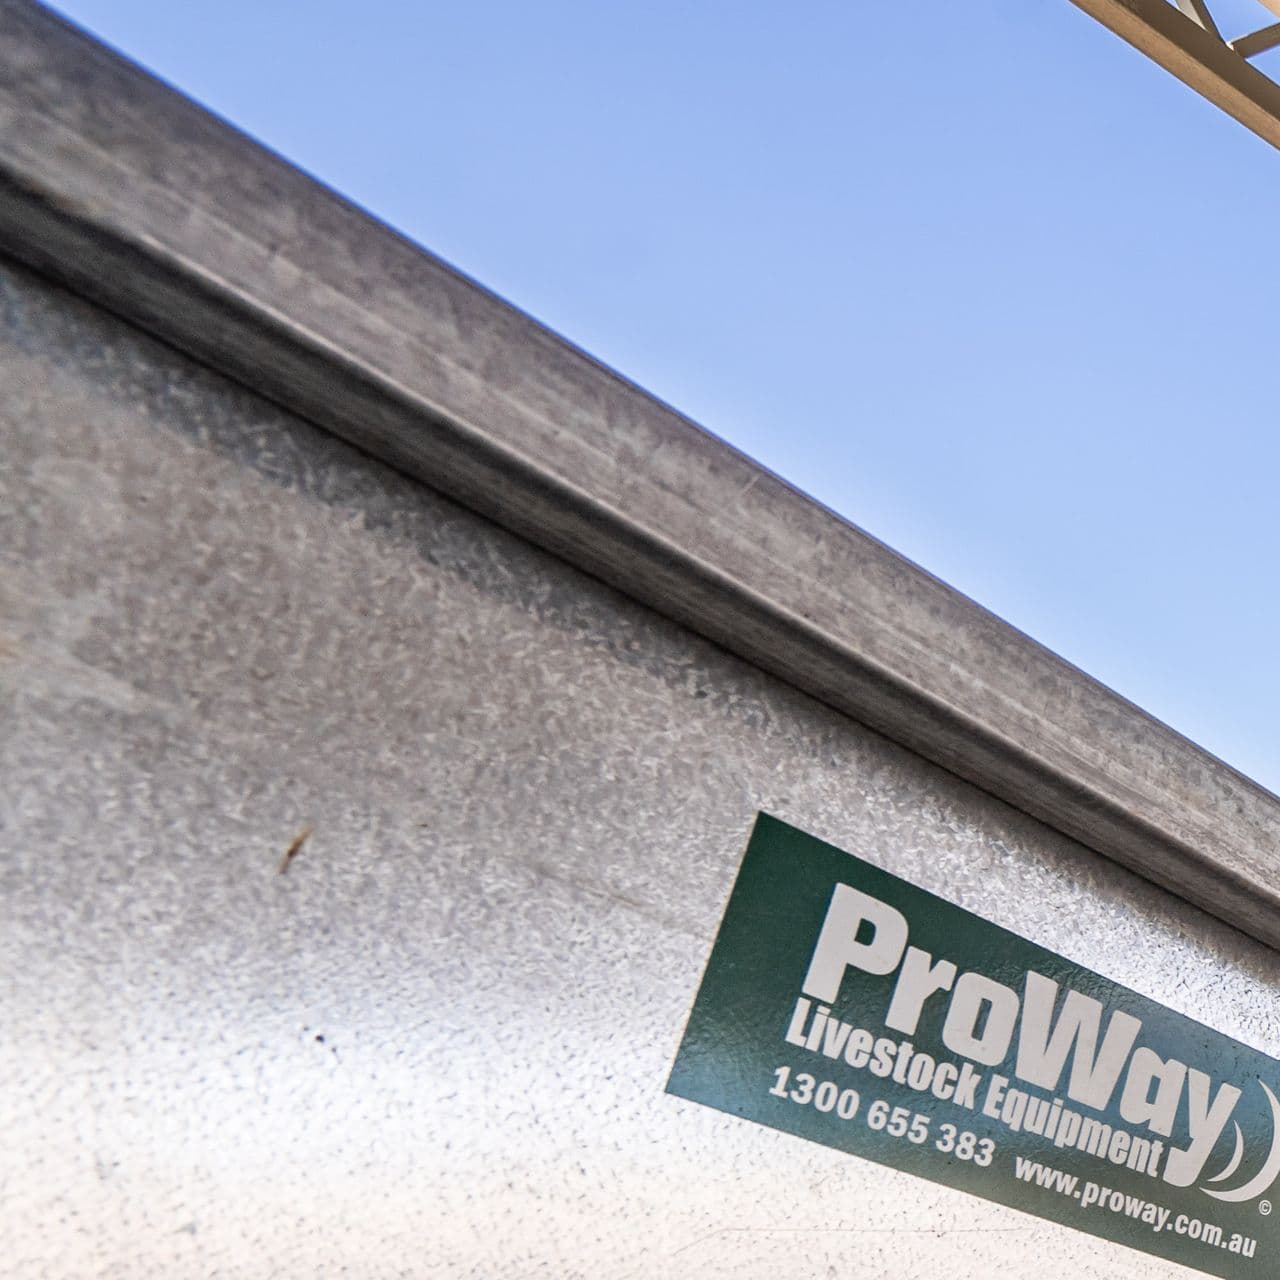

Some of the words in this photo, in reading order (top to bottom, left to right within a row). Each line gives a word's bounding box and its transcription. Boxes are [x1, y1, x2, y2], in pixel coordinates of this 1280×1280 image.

[784, 997, 982, 1111] Livestock
[981, 1073, 1165, 1179] Equipment
[801, 881, 1242, 1187] ProWay
[768, 1065, 860, 1121] 1300
[866, 1099, 931, 1145] 655
[935, 1123, 996, 1168] 383
[1014, 1155, 1257, 1259] www.proway.com.au
